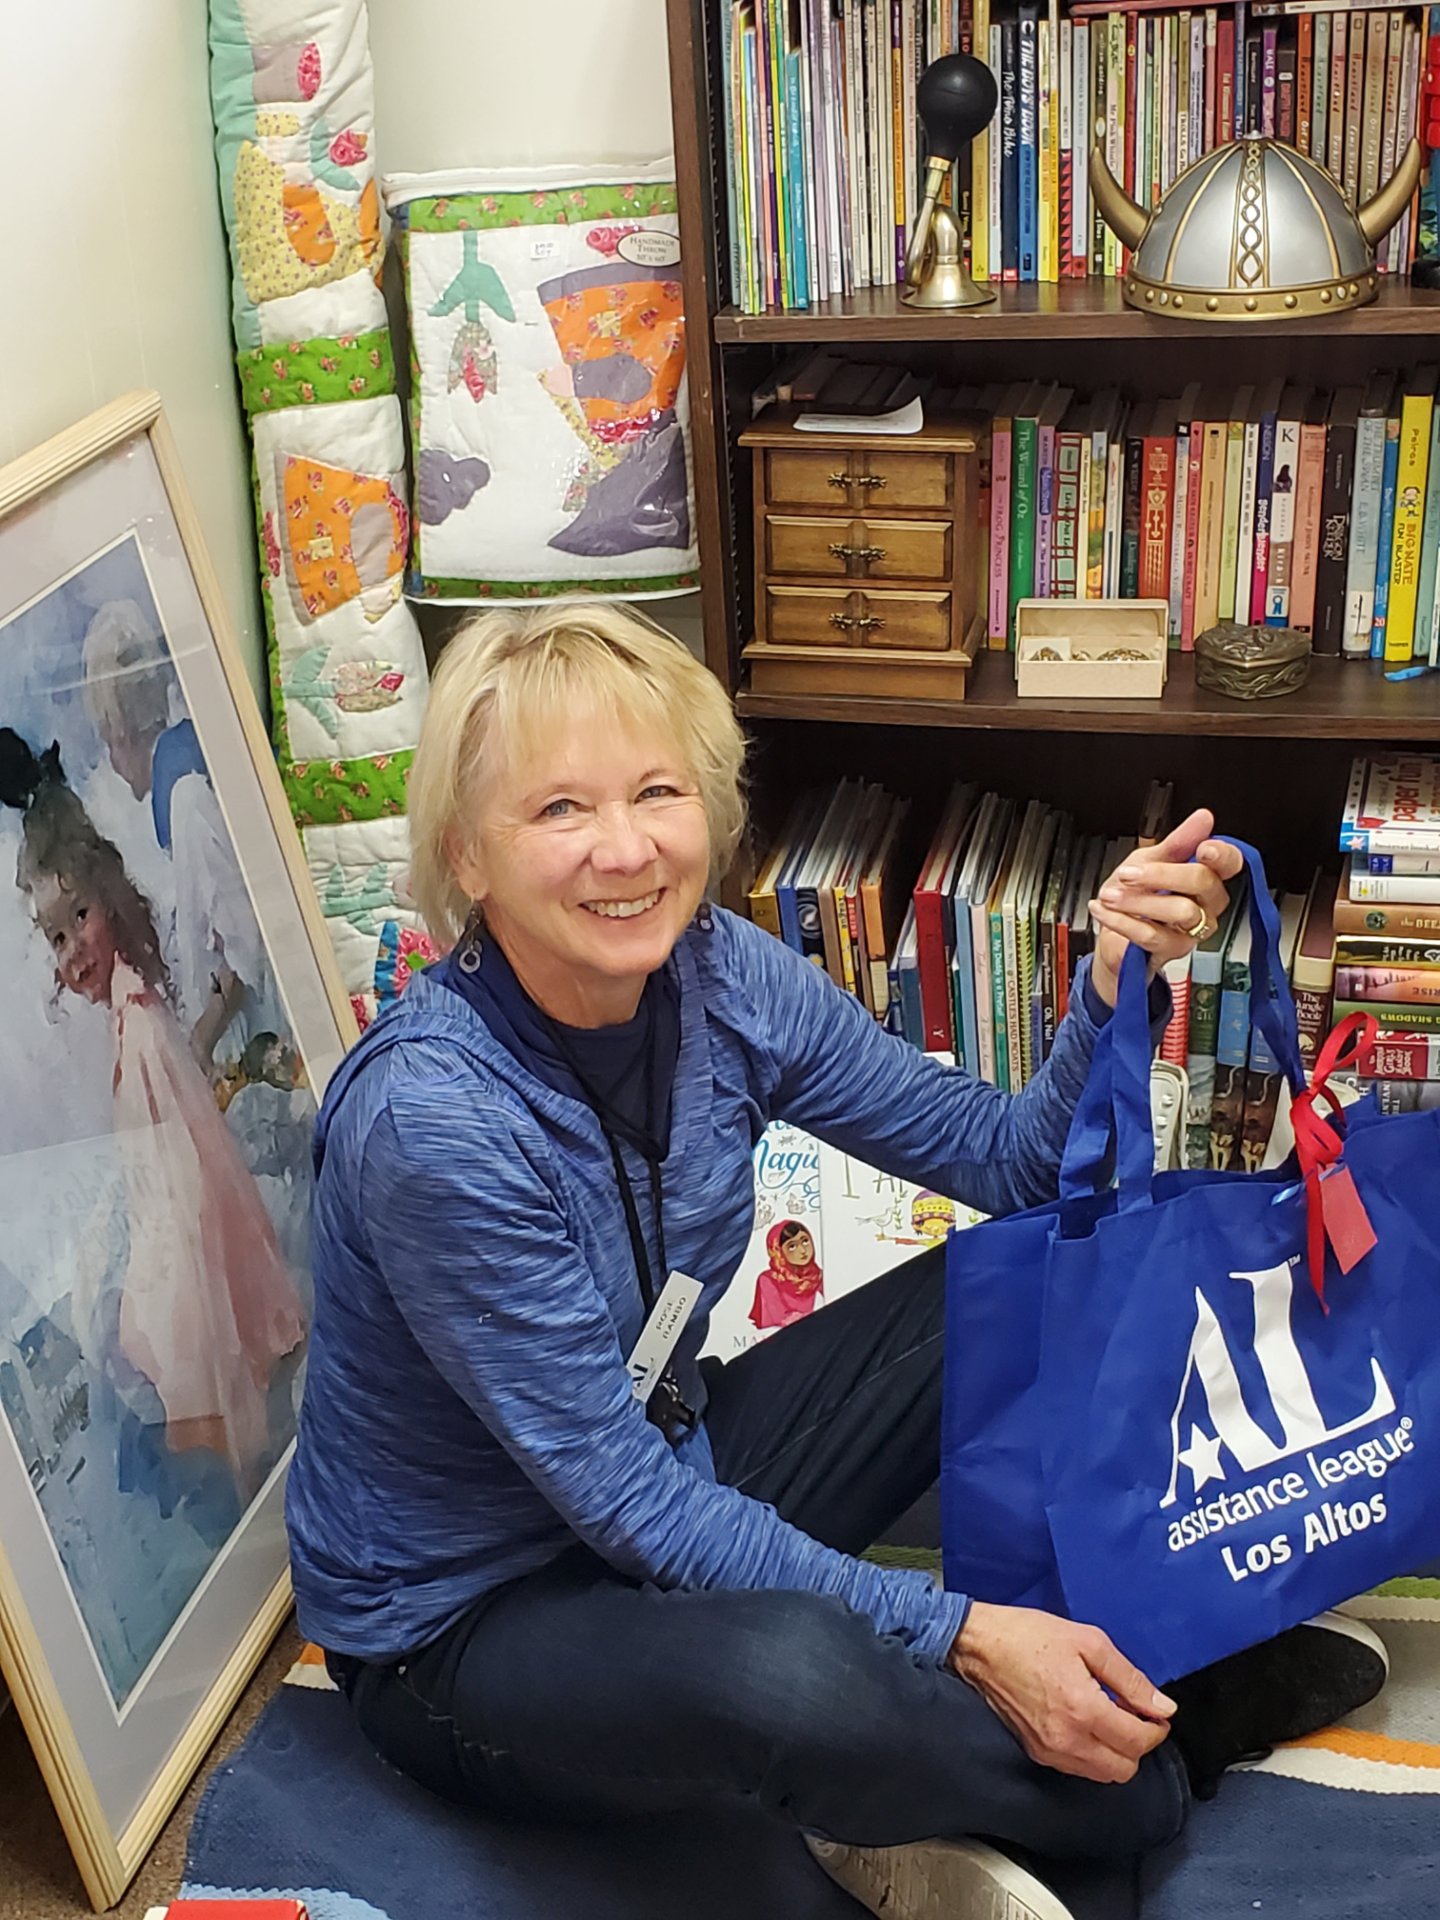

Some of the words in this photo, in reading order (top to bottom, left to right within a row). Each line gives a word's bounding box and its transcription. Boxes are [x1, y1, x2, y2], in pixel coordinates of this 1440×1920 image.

[1020, 40, 1035, 67] THE
[1003, 71, 1016, 92] The
[1003, 127, 1016, 158] Bike
[1020, 107, 1035, 149] BOOK
[1018, 429, 1031, 450] The
[1262, 425, 1273, 461] NELSON
[1281, 428, 1295, 443] K
[1017, 451, 1030, 488] Wizard
[1016, 488, 1028, 501] of
[1016, 503, 1028, 519] Oz
[1062, 520, 1073, 537] Out
[1331, 515, 1346, 561] DRAGON
[1395, 523, 1405, 540] FUN
[1404, 523, 1417, 549] BIG
[993, 533, 1006, 578] PRINCESS
[1274, 548, 1287, 584] kira-k
[1393, 544, 1403, 585] BLASTER
[1402, 549, 1416, 585] NATE
[1392, 786, 1426, 823] paper
[992, 939, 1001, 951] My
[993, 952, 1002, 975] Daddy
[1007, 980, 1017, 1019] CASTLES
[1302, 992, 1321, 1002] The
[1296, 1009, 1322, 1020] Book
[1380, 1013, 1433, 1025] SHADOWS
[1009, 1022, 1018, 1039] HAD
[1011, 1041, 1019, 1072] MOATS
[1382, 1080, 1391, 1115] INVENT
[1168, 1473, 1308, 1551] assistance
[1221, 1534, 1292, 1582] Los
[1303, 1493, 1388, 1554] Altos
